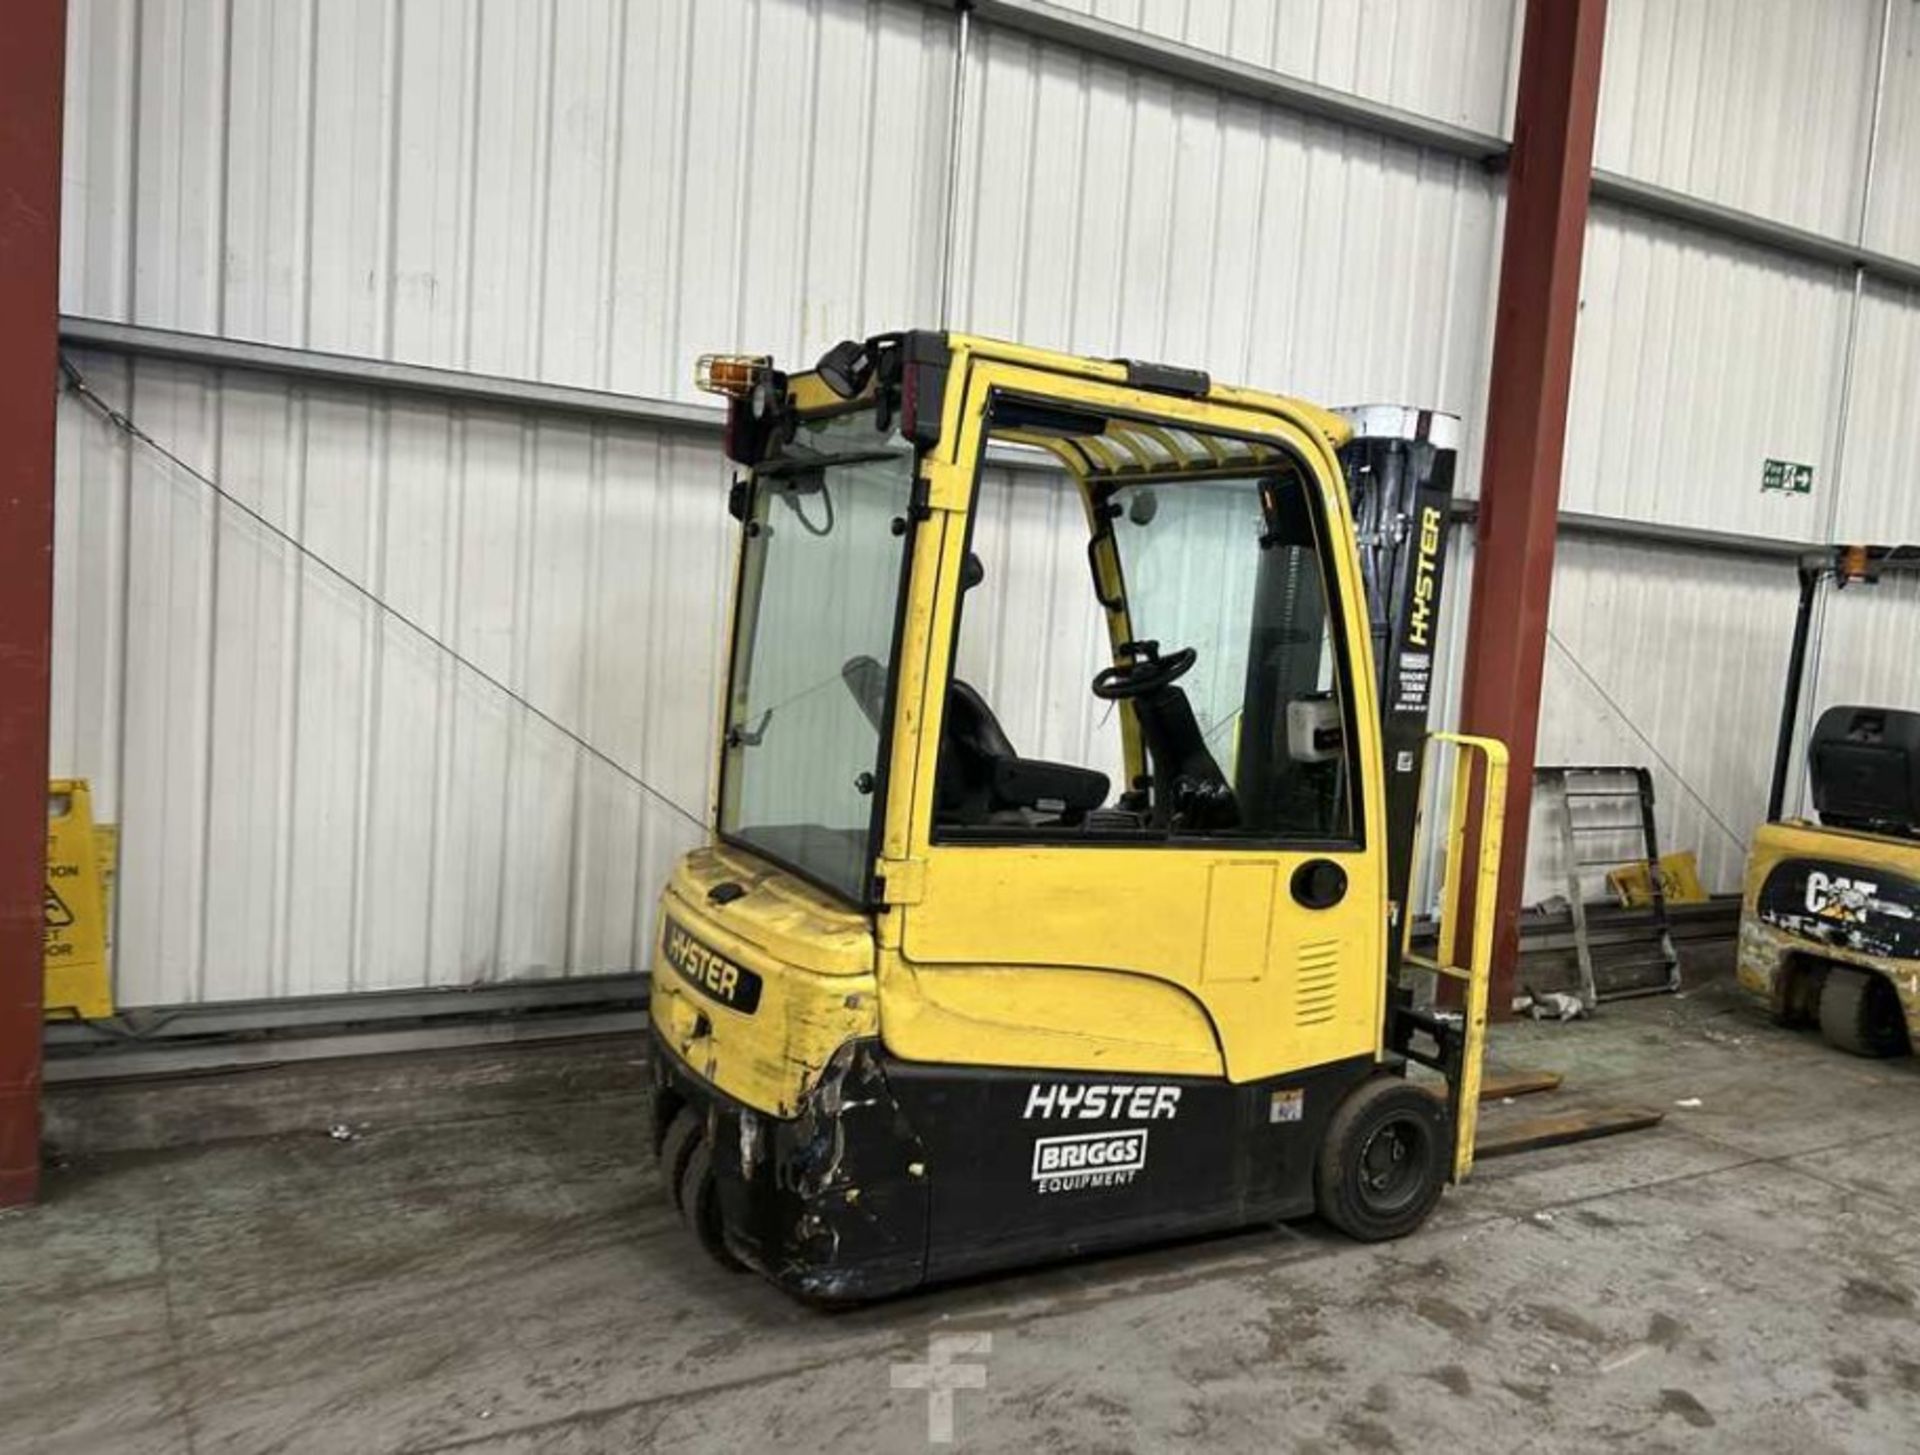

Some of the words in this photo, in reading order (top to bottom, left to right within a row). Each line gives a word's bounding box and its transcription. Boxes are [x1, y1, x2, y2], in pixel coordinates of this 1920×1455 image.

[1409, 507, 1441, 646] HYSTER
[668, 926, 739, 1001] HYSTER
[1023, 1084, 1181, 1119] HYSTER
[1041, 1138, 1139, 1171] BRIGGS
[1038, 1171, 1137, 1194] EQUIPMENT
